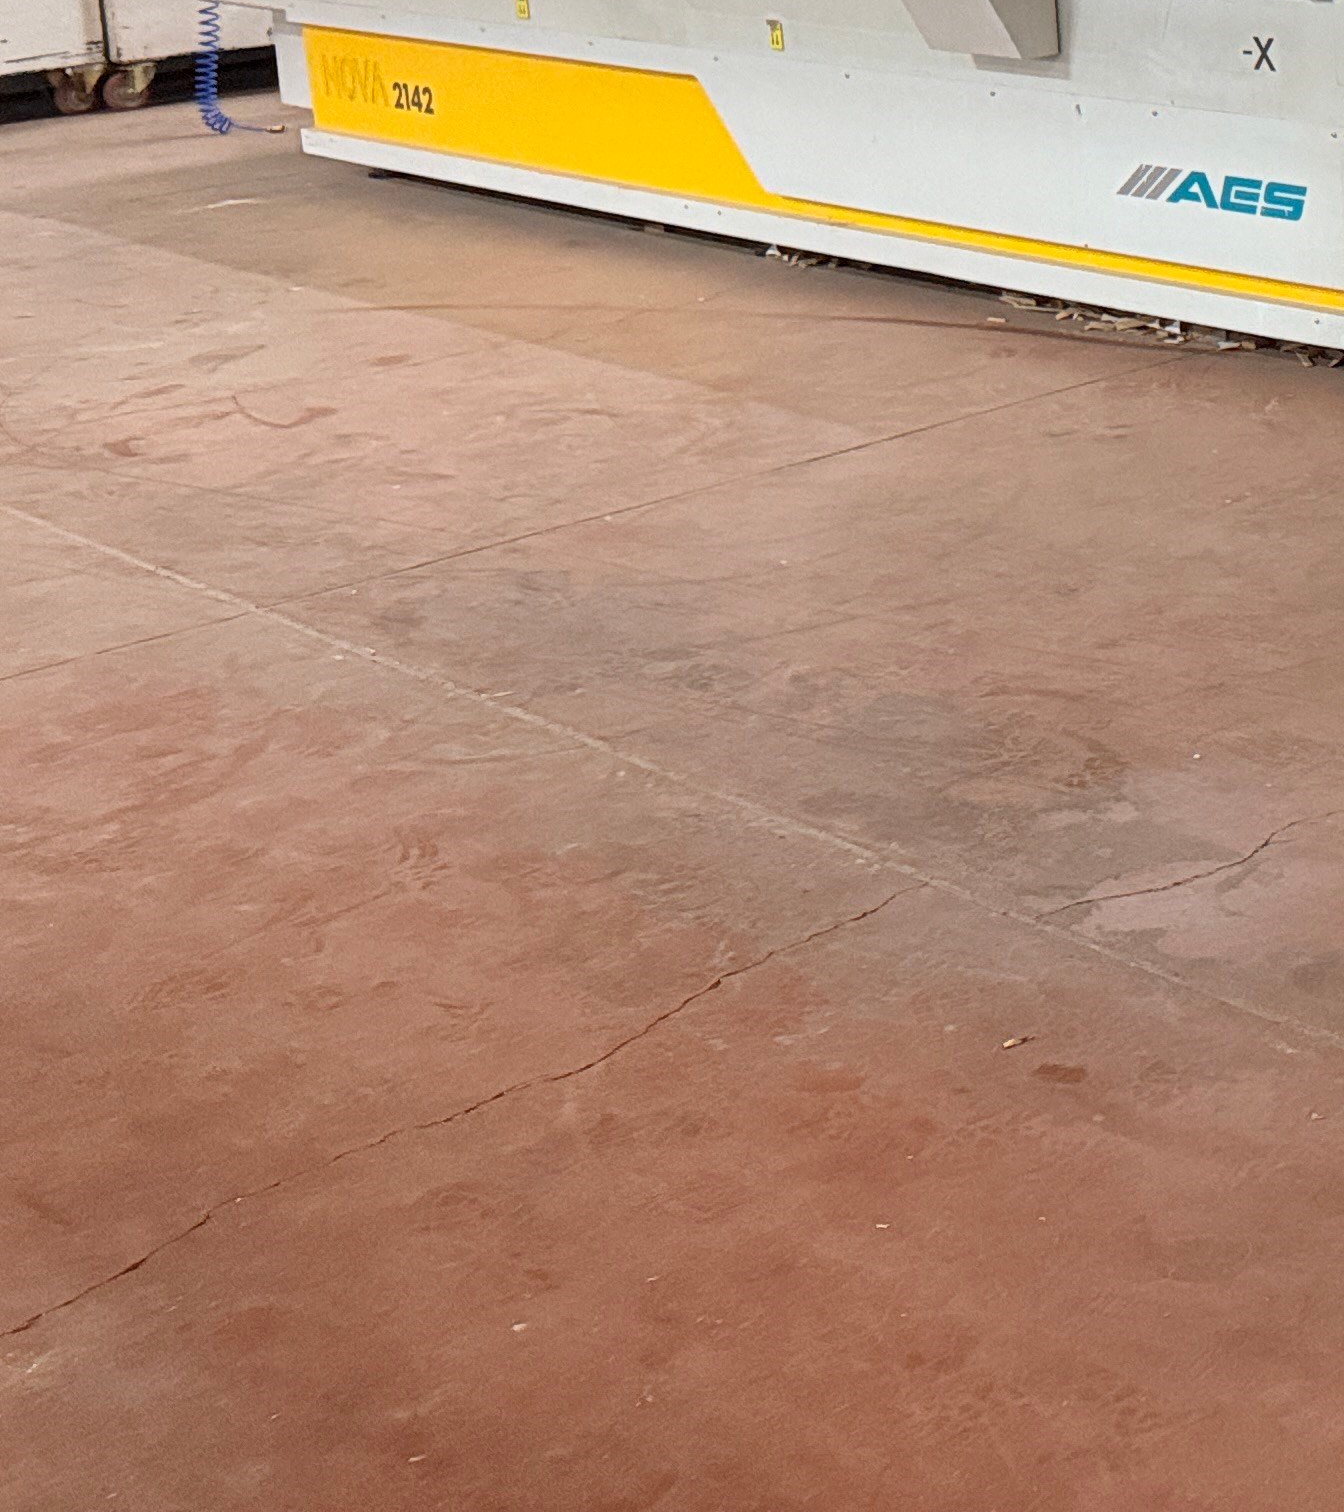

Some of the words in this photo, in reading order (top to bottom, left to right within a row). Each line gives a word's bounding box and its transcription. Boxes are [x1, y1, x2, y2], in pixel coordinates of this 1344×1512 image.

[1243, 36, 1276, 72] -X
[392, 81, 435, 115] 2142
[1166, 170, 1308, 222] AES
